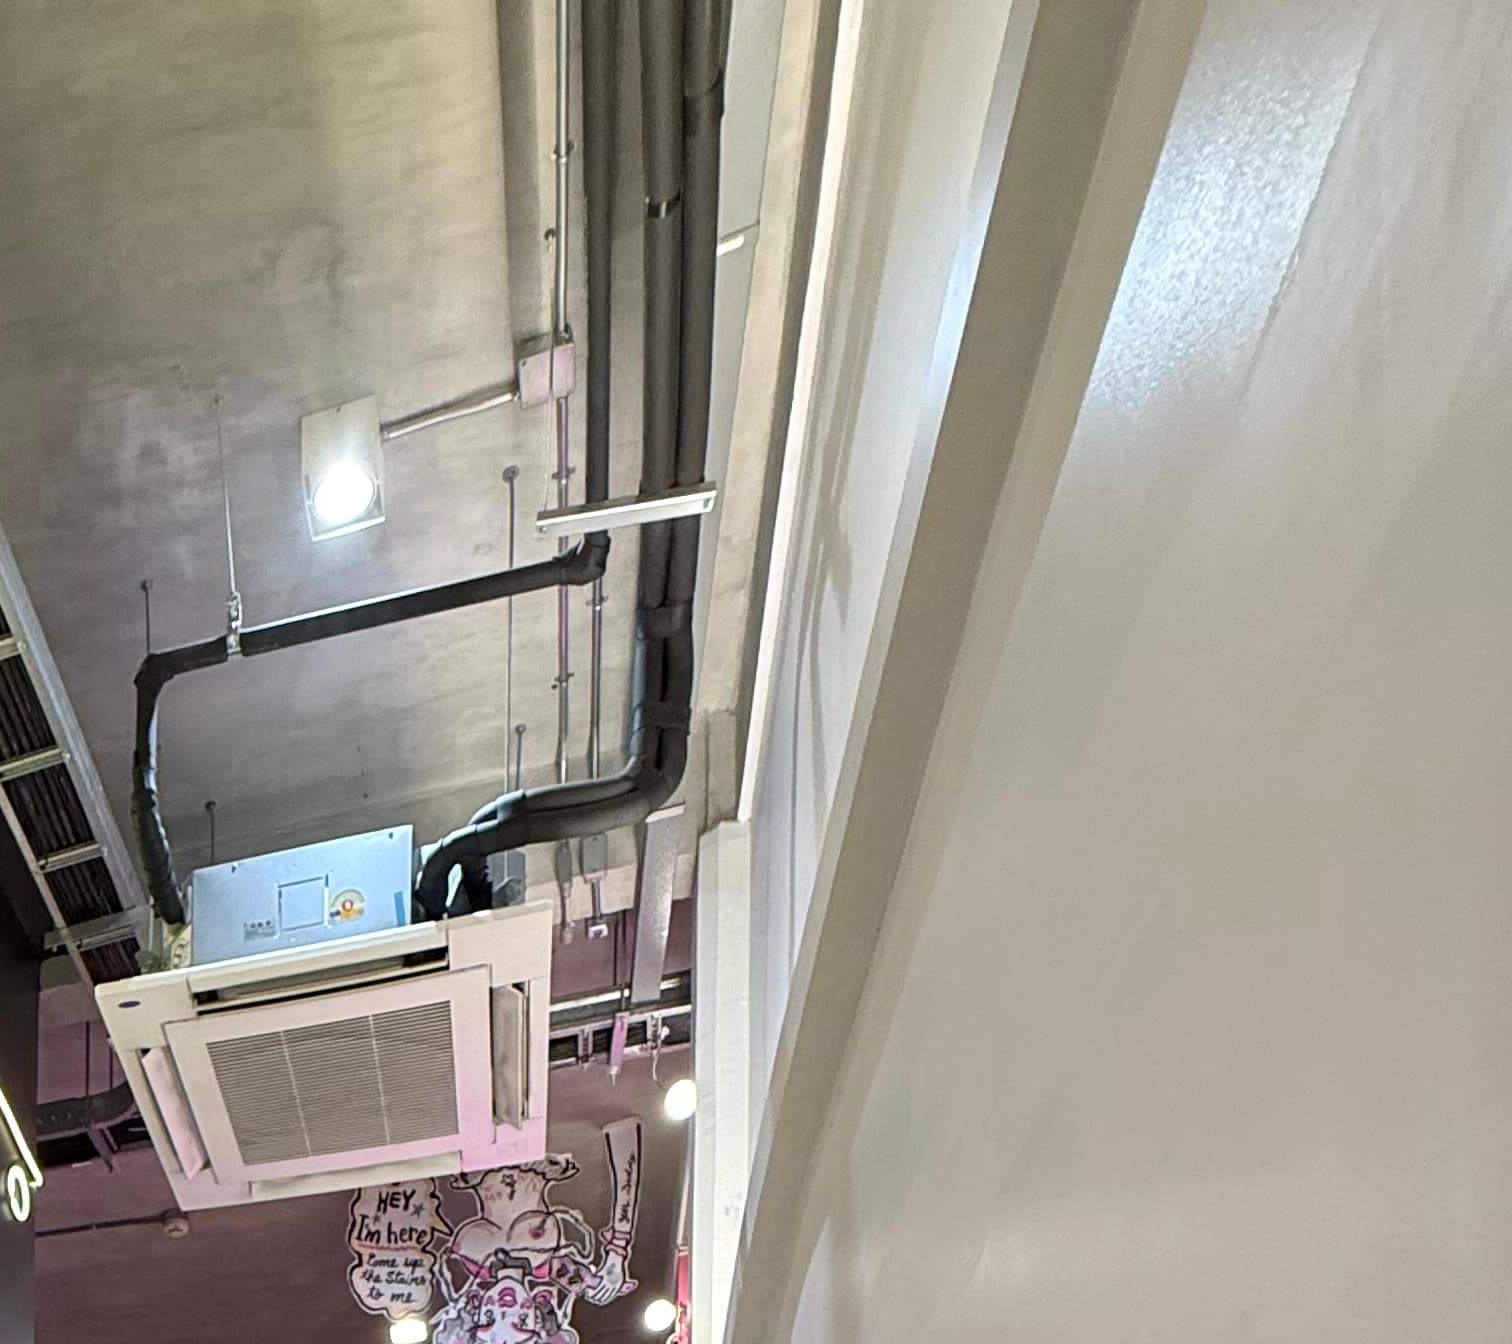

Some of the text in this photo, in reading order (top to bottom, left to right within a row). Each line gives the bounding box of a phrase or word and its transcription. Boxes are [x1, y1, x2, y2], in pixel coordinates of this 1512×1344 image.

[376, 1189, 416, 1214] HEY
[387, 1221, 427, 1245] here
[360, 1269, 381, 1284] the
